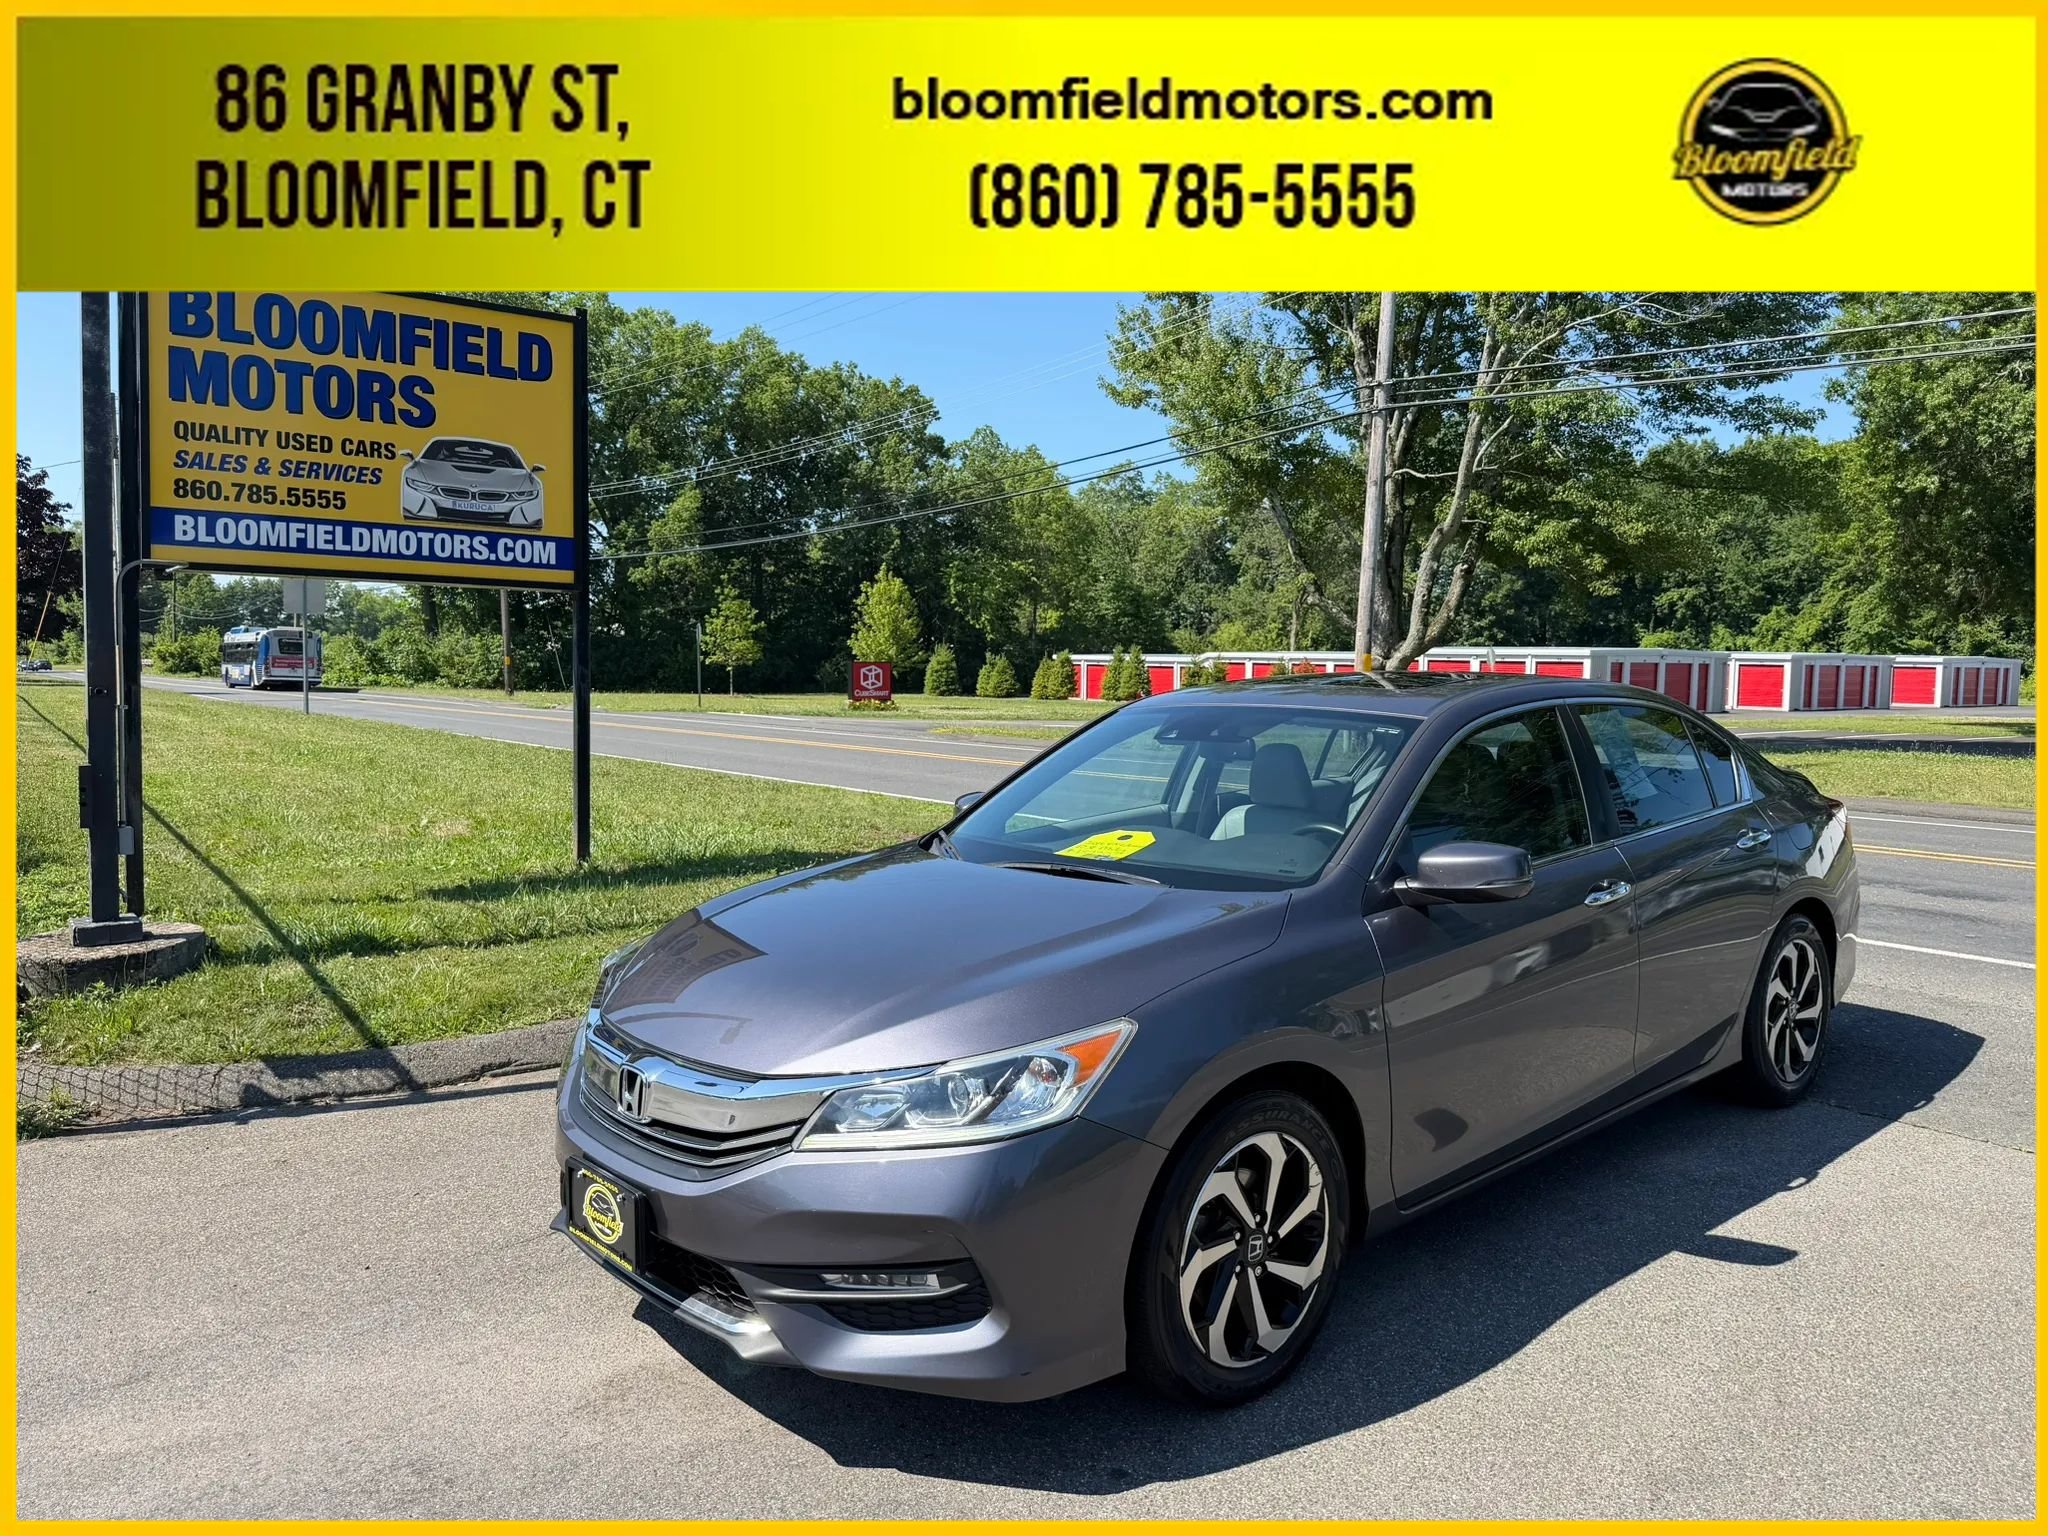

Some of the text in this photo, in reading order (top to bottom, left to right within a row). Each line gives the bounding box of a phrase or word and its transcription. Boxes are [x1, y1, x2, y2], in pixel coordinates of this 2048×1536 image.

[168, 291, 553, 382] BLOOMFIELD
[168, 345, 437, 428] MOTORS
[173, 420, 396, 460] QUALITY USED CARS
[173, 450, 382, 485] SALES & SERVICES
[173, 478, 347, 510] 860.785.5555
[174, 514, 556, 565] BLOOMFIELDMOTORS.COM
